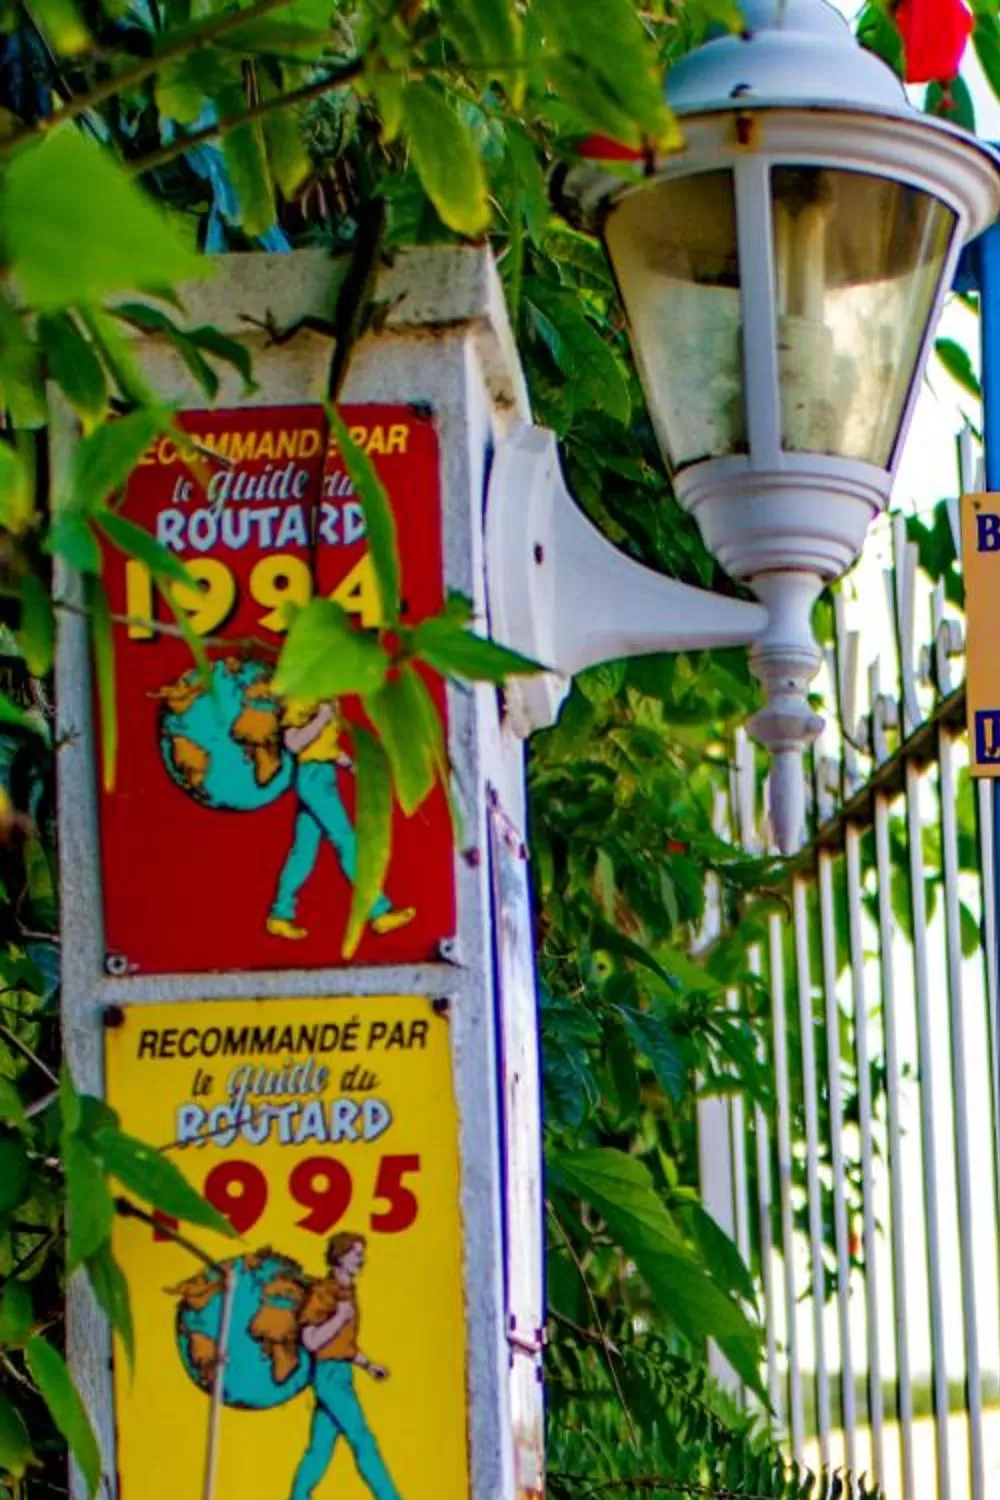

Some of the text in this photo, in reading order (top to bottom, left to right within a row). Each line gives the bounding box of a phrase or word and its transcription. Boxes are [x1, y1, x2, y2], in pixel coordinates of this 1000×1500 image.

[172, 475, 194, 503] le
[207, 461, 309, 518] guide
[157, 502, 368, 552] ROUTARD
[125, 553, 384, 639] 1994
[138, 1016, 429, 1059] RECOMMANDÉ PAR
[192, 1057, 380, 1112] le guide du
[175, 1096, 393, 1149] ROUTARD
[152, 1154, 421, 1242] 995
